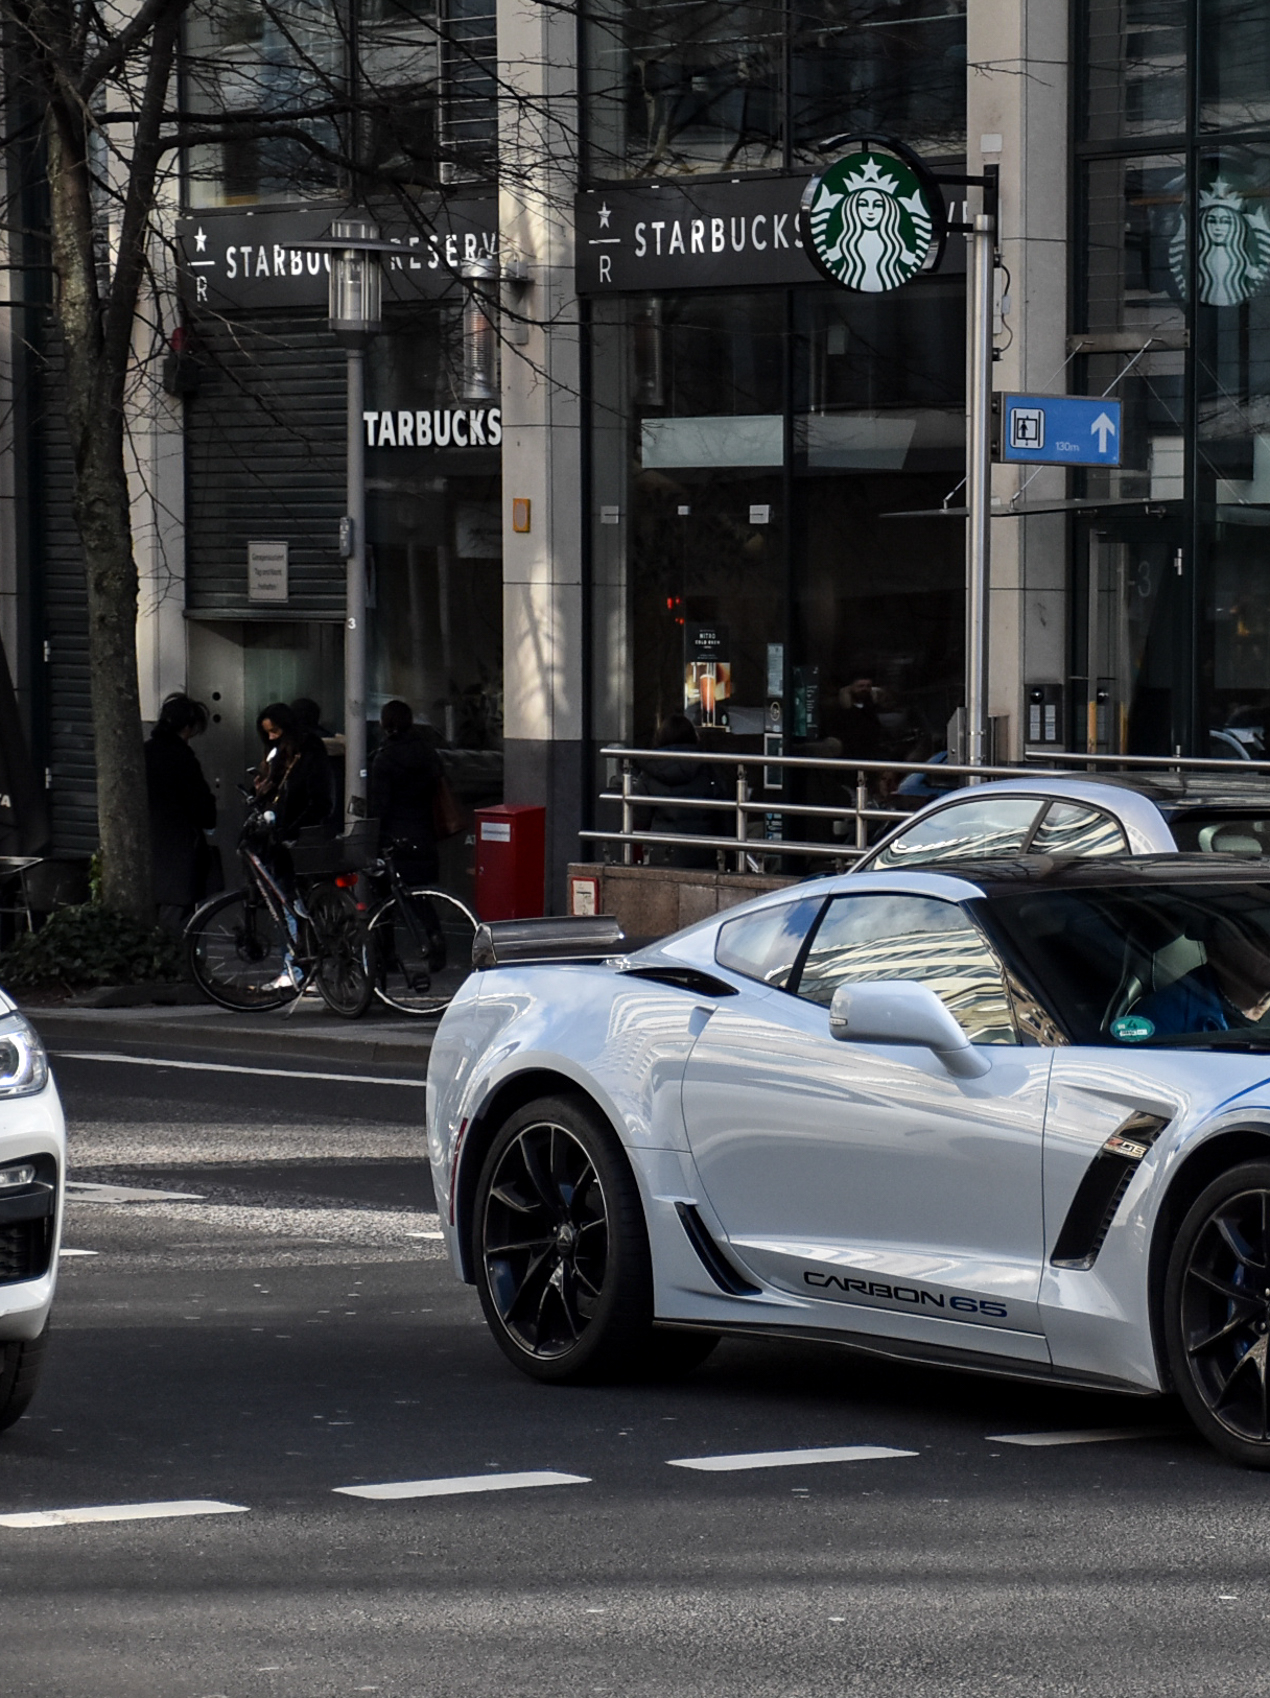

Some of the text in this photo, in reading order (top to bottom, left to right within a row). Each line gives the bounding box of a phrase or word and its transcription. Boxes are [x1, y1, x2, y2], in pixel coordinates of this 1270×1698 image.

[225, 243, 333, 280] STARBU
[1055, 441, 1080, 452] 130m
[803, 1271, 1008, 1318] CARBON 65
